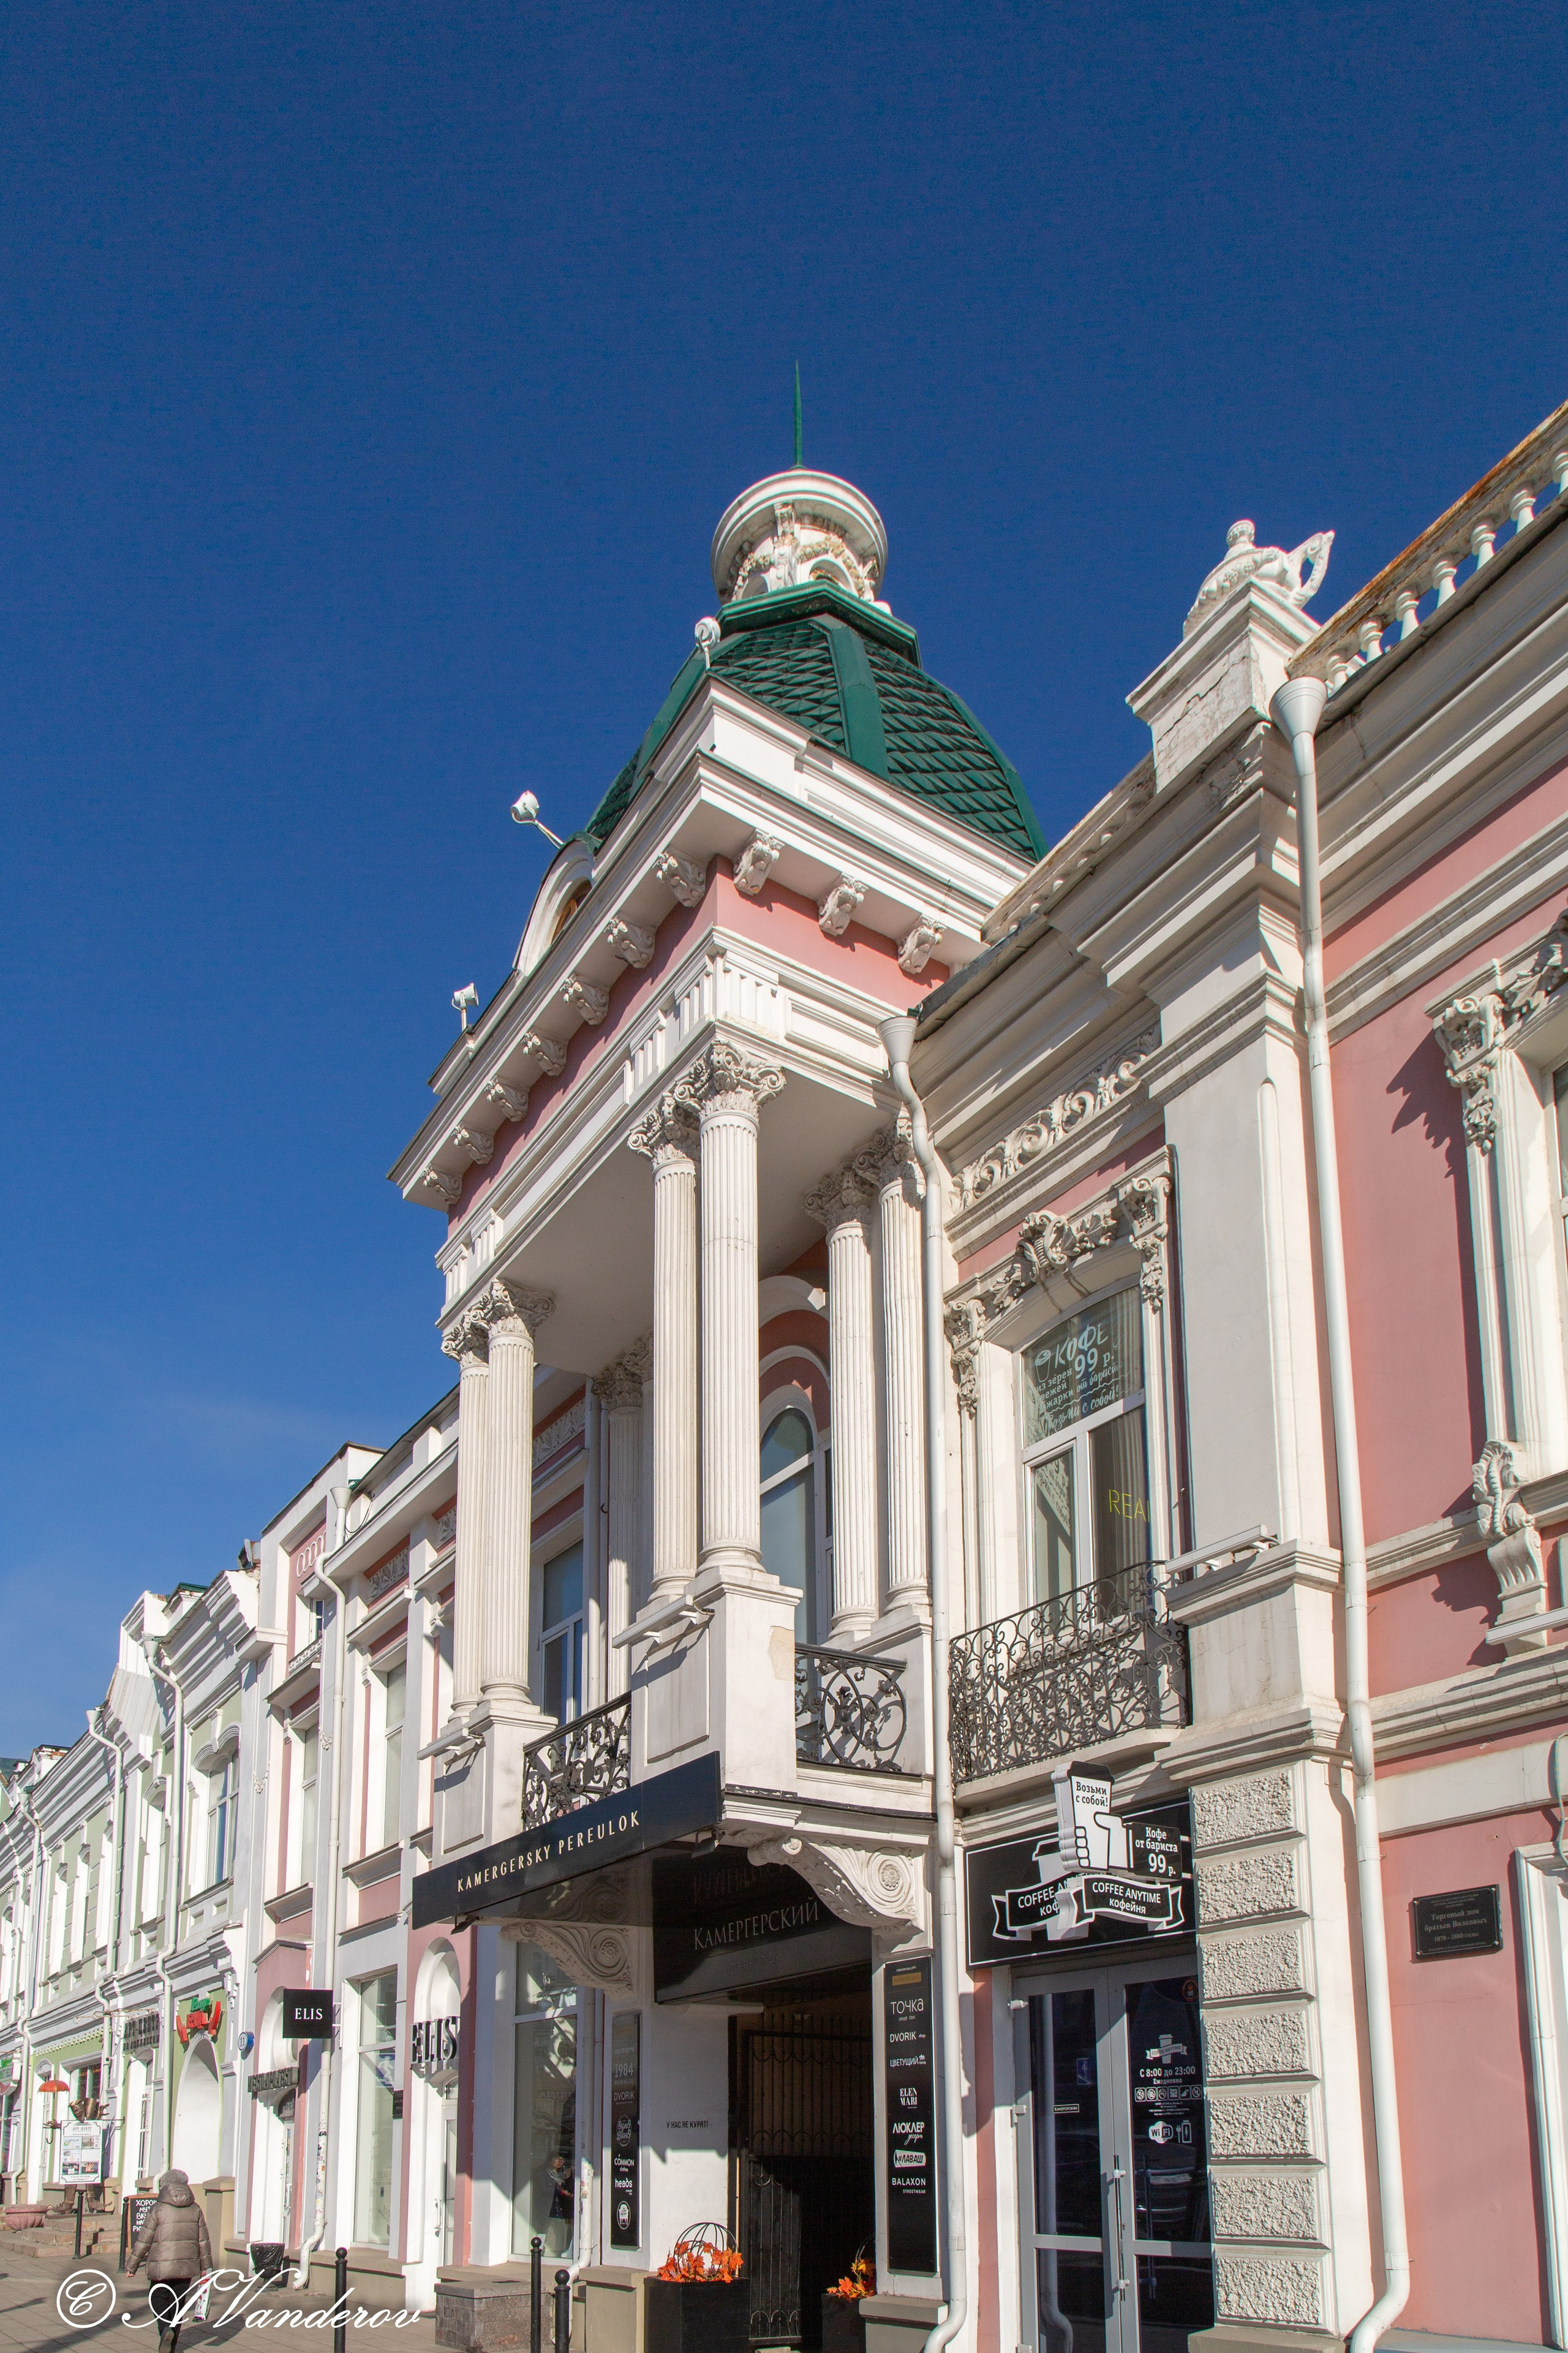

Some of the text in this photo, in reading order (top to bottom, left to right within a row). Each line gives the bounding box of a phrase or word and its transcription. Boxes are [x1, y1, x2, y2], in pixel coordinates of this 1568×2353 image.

[1055, 1324, 1108, 1369] КОФЕ
[1074, 1348, 1098, 1380] 99
[1076, 1781, 1107, 1796] Возьми
[1082, 1794, 1108, 1807] собой!
[1145, 1827, 1167, 1841] Кофе
[457, 1810, 640, 1893] KAMERGERSKY PEREULOK
[1135, 1838, 1178, 1853] от бариста
[1148, 1853, 1176, 1876] 99 р.
[1018, 1886, 1055, 1908] COFFEE
[1092, 1882, 1161, 1904] COFFEE ANYTIME
[1109, 1898, 1146, 1915] кофейня
[1431, 1909, 1465, 1921] Торговый
[1424, 1917, 1488, 1932] братьев Волковых
[295, 2007, 323, 2020] ELIS
[410, 2015, 459, 2064] ELIS
[890, 2031, 916, 2042] DVORIK
[890, 2056, 919, 2068] ЦВЕТУЩИЙ
[1146, 2068, 1162, 2077] 8:00
[1164, 2069, 1173, 2077] до
[1174, 2066, 1196, 2075] 23:00
[614, 2091, 635, 2101] DVORIK
[898, 2155, 923, 2164] #ЛАВАШ
